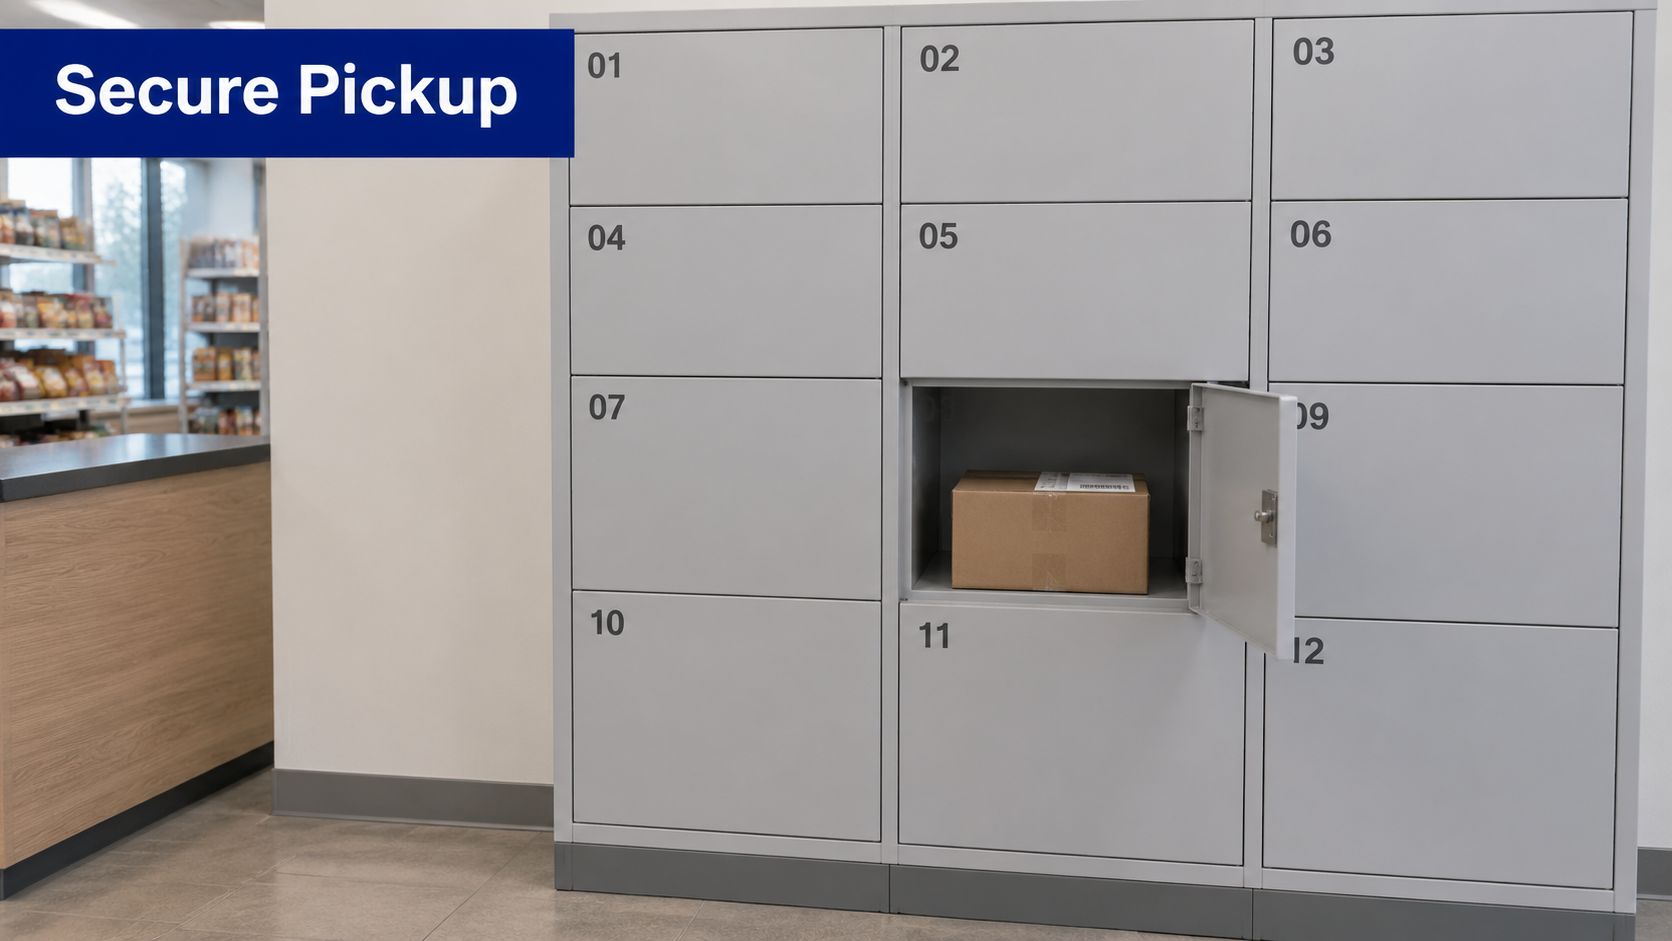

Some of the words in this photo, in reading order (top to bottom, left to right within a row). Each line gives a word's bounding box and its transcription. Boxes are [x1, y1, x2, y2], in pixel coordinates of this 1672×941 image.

[587, 51, 620, 79] 01
[920, 44, 960, 73] 02
[1293, 36, 1335, 66] 03
[587, 224, 626, 251] 04
[919, 222, 959, 250] 05
[1290, 219, 1332, 248] 06
[589, 393, 626, 421] 07
[590, 608, 625, 636] 10
[918, 621, 949, 649] 11
